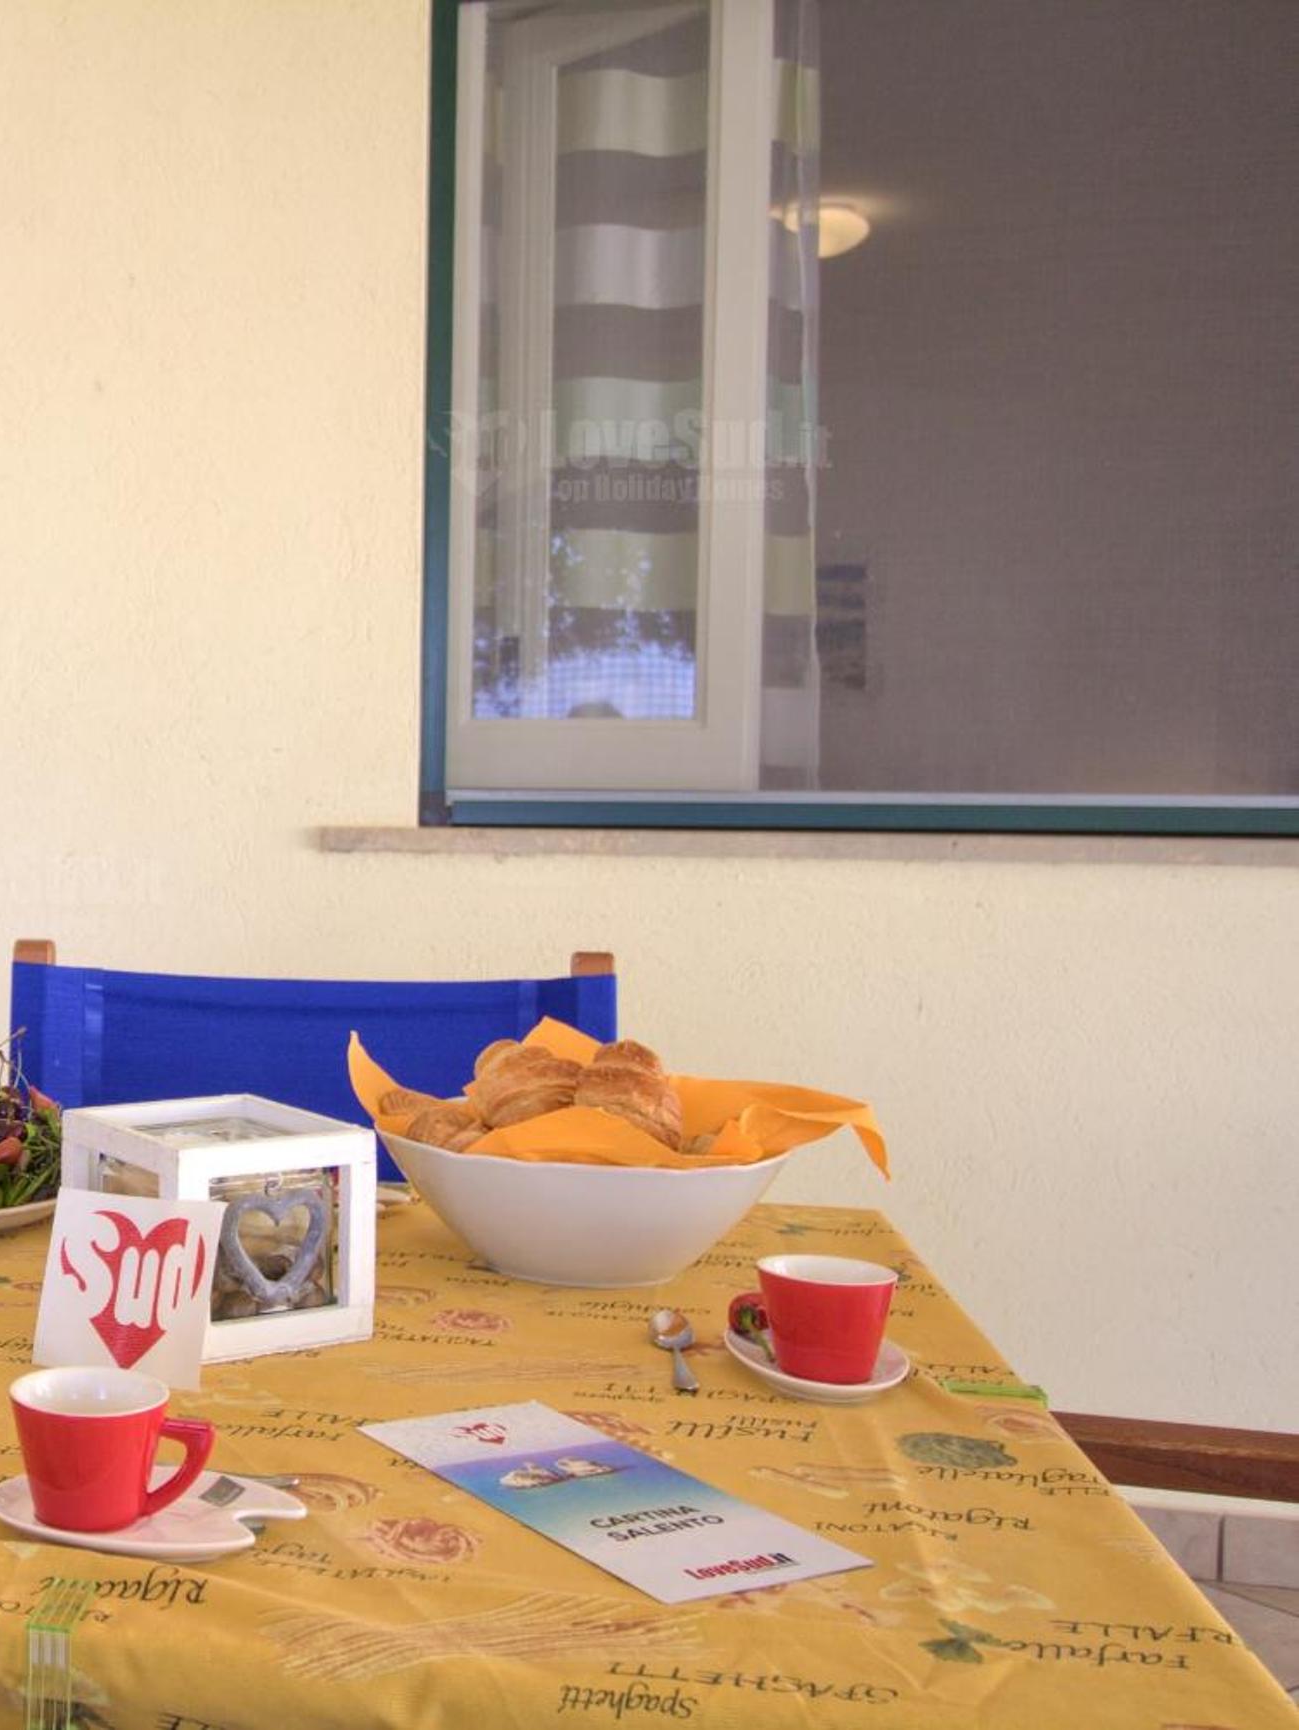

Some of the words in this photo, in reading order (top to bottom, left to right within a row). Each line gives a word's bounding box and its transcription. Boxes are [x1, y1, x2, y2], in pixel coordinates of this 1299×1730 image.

[665, 1420, 817, 1444] Fusilli
[589, 1502, 700, 1531] CARTINA
[606, 1513, 725, 1543] SALENTO
[862, 1498, 1033, 1534] Rigatoni
[683, 1552, 794, 1581] LoveSud.it
[604, 1661, 901, 1707] SPAGHETTI
[556, 1682, 699, 1721] Spaghetti
